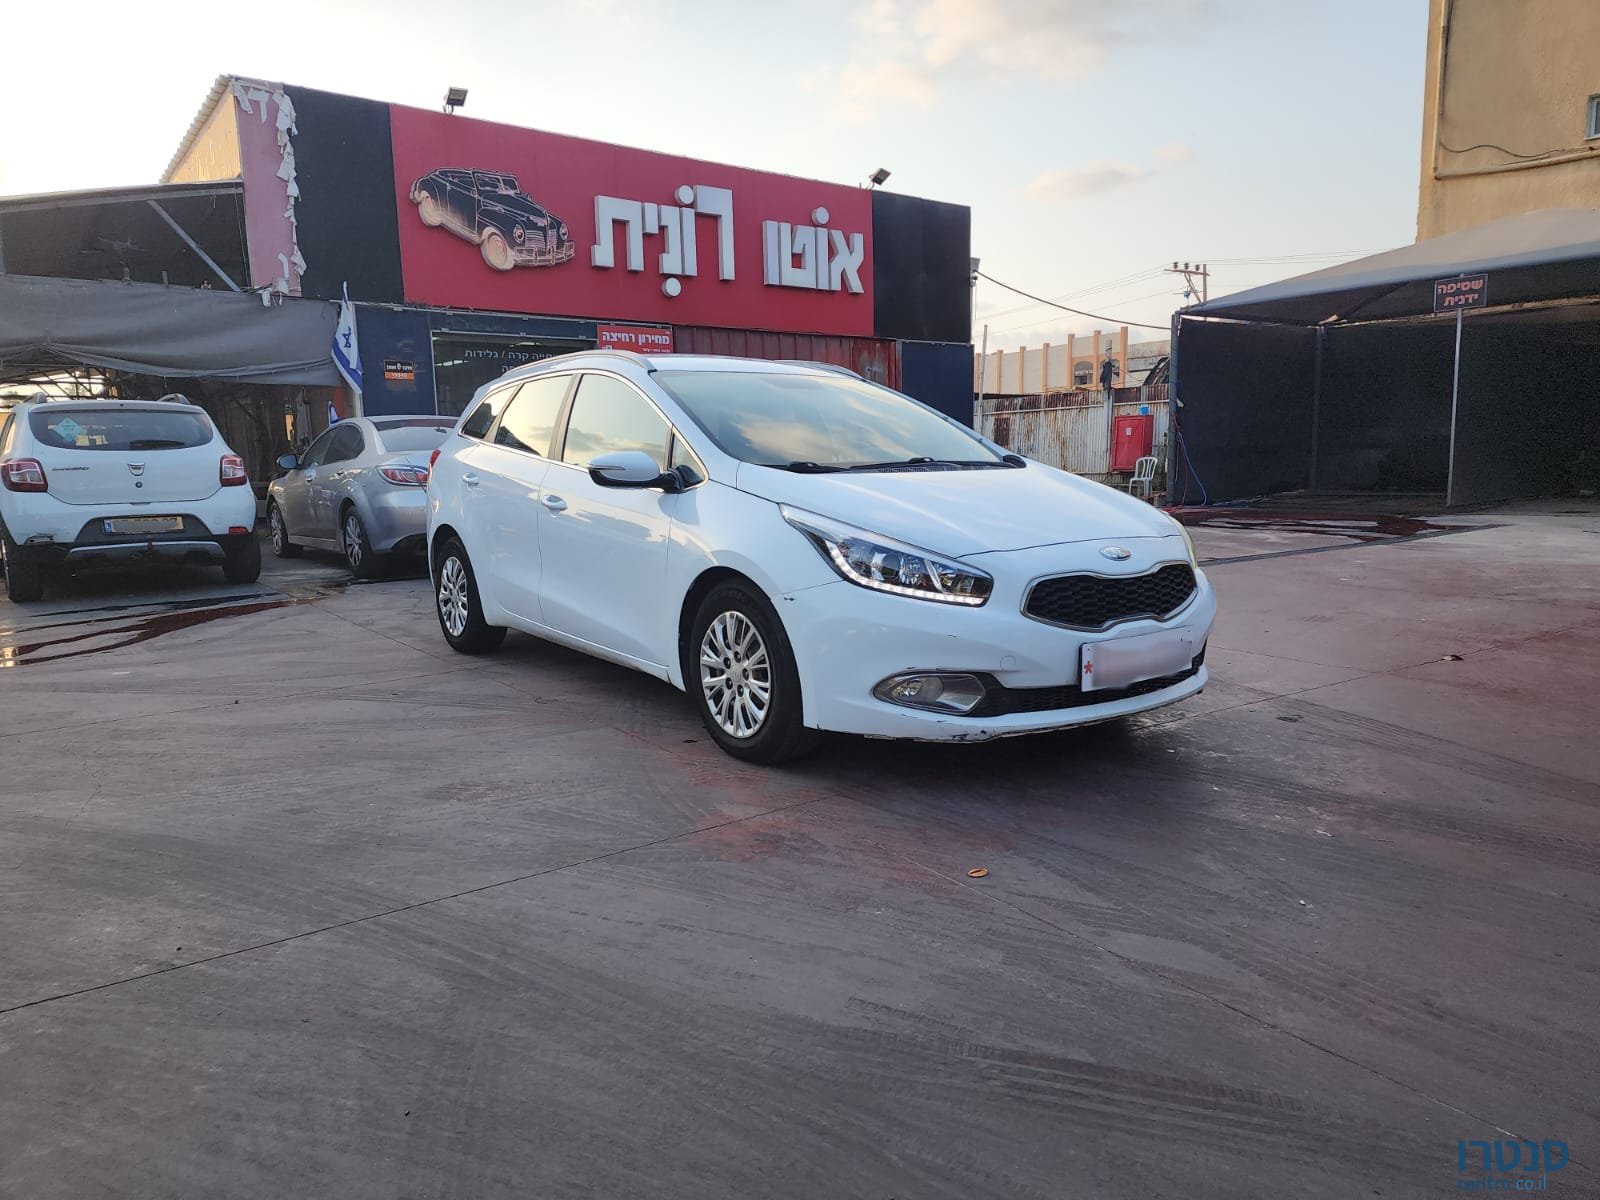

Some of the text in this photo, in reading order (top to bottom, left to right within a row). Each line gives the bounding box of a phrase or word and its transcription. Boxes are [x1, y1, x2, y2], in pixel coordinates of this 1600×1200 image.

[1443, 293, 1479, 307] ידנית
[602, 331, 670, 346] מחירון רחיצה
[464, 349, 499, 359] גלידות
[508, 351, 529, 361] קרה
